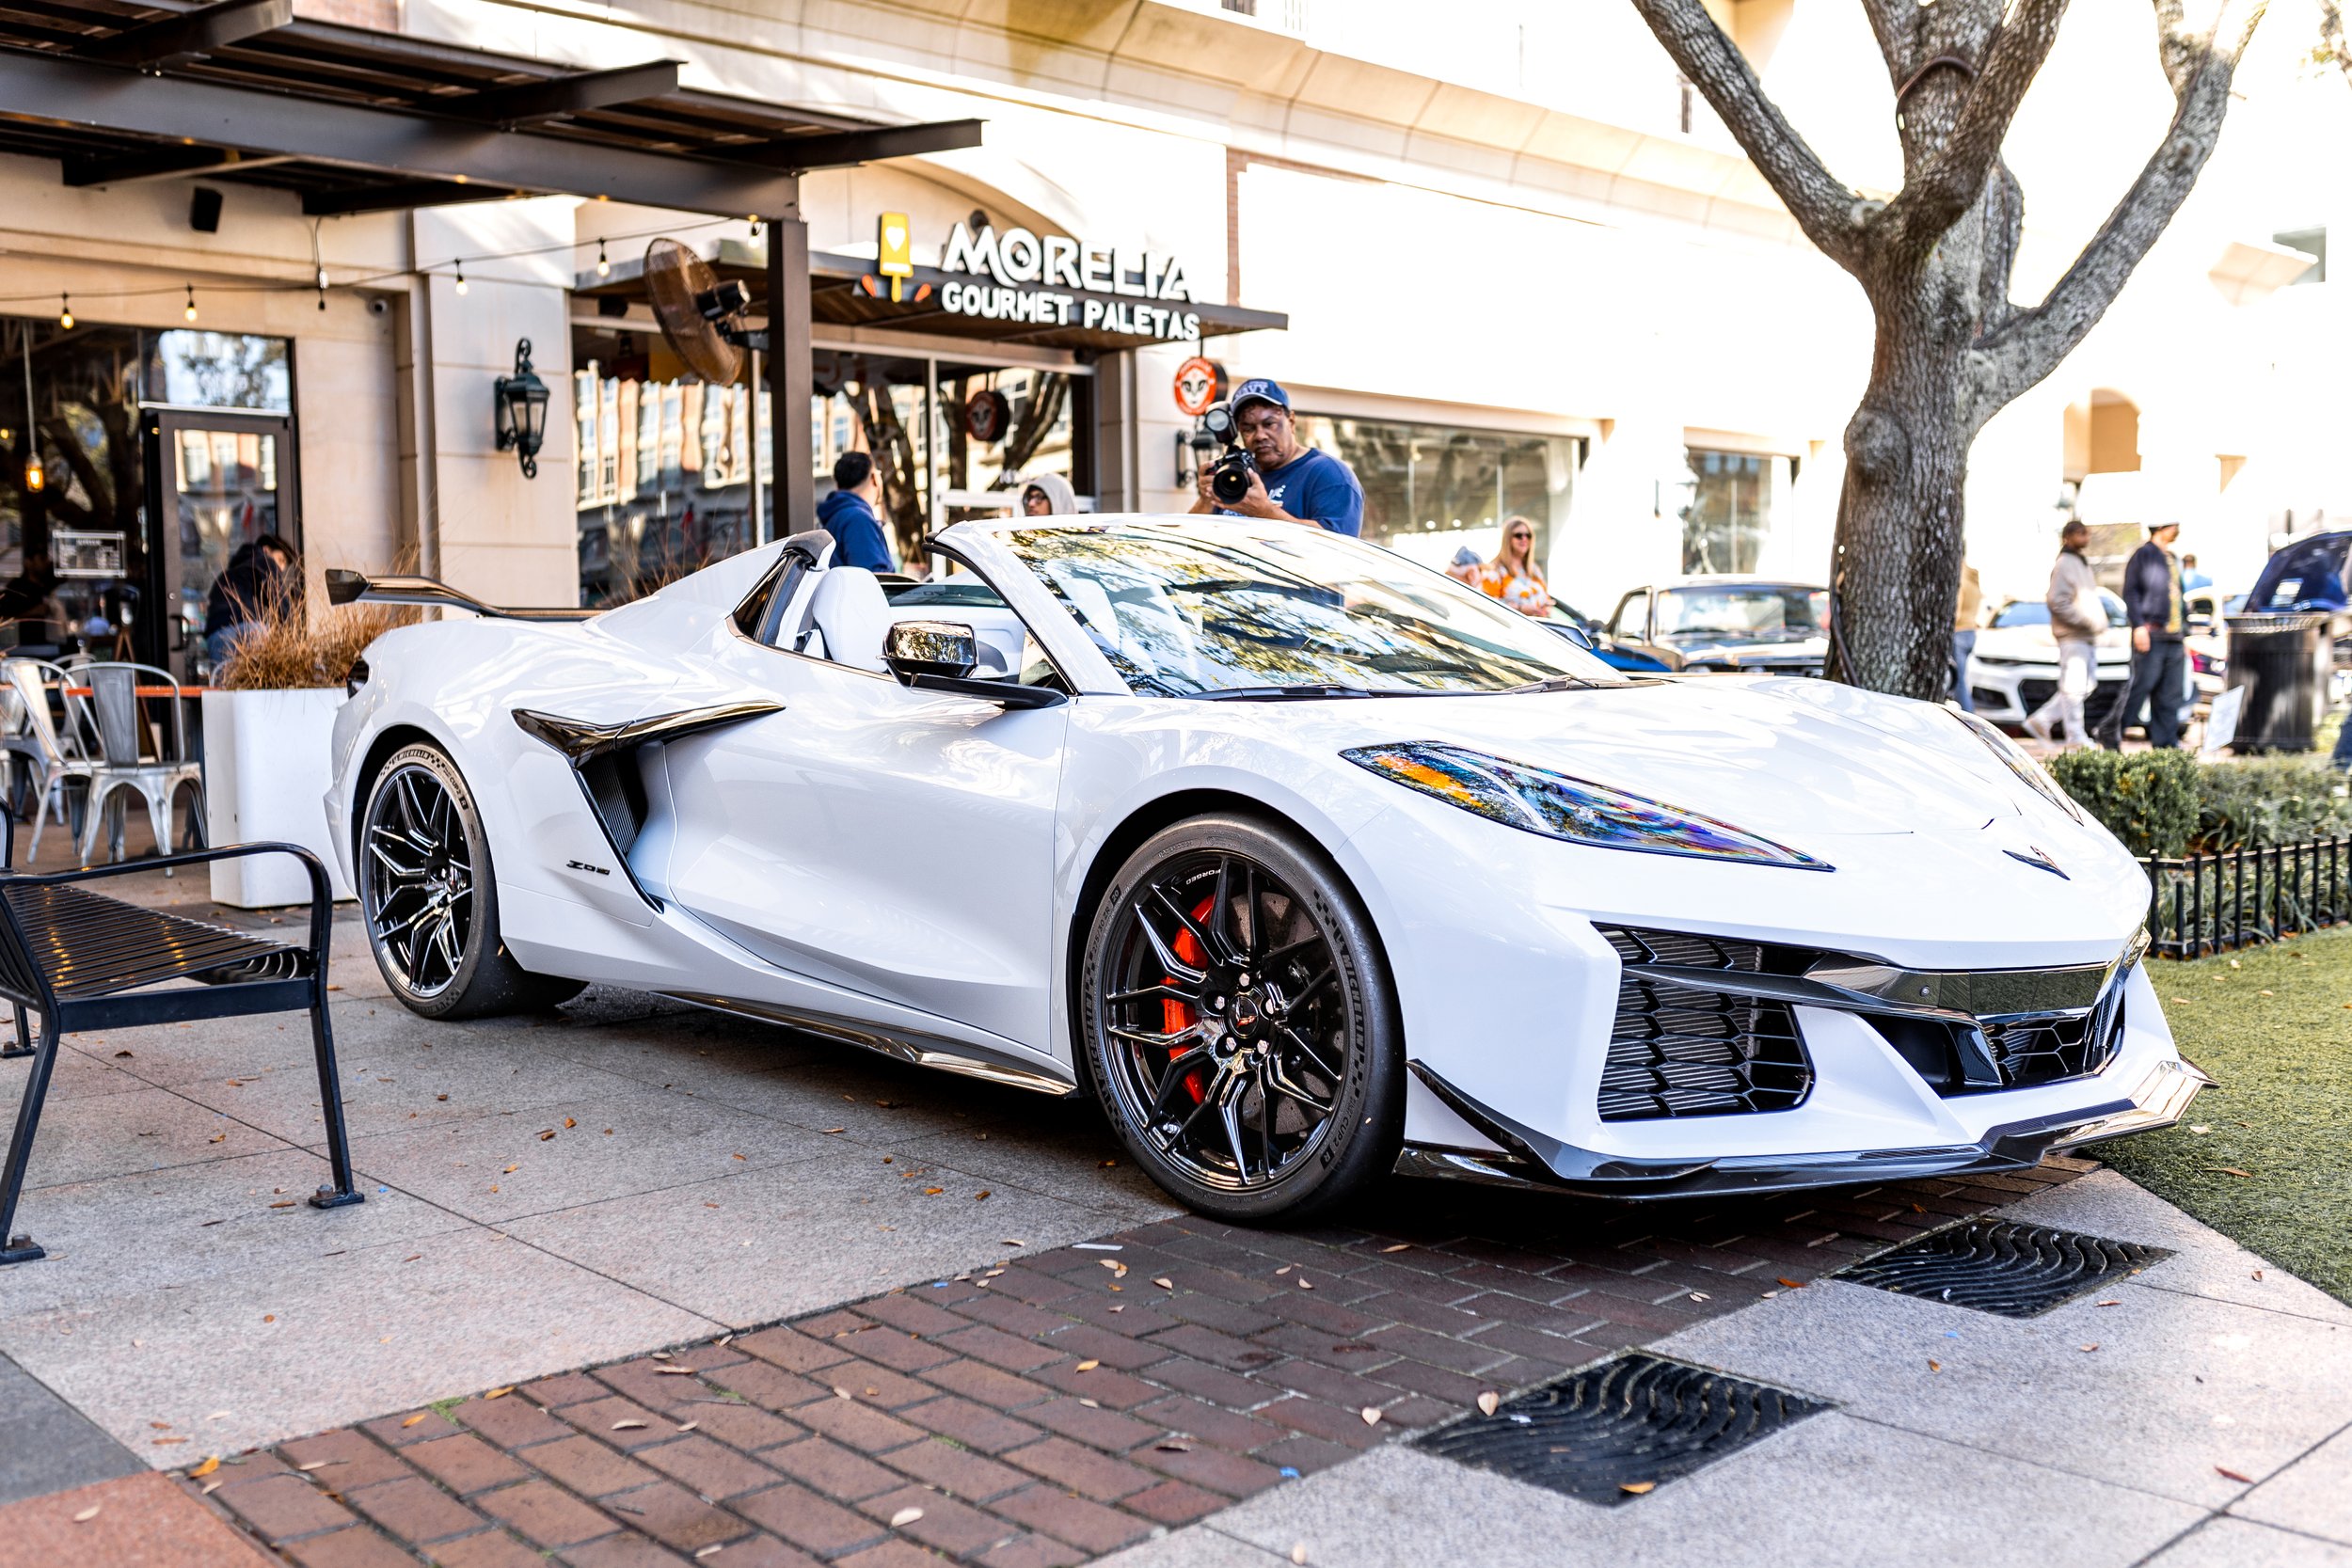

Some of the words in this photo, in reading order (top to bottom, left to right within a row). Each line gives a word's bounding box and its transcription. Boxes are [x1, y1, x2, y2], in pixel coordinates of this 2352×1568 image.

[942, 222, 1201, 305] MORELIA
[942, 282, 1073, 325] GOURMET
[1084, 299, 1200, 341] PALETAS
[1110, 889, 1119, 902] 20
[1185, 868, 1221, 885] FORGED
[1342, 954, 1364, 1048] MICHELIN
[1086, 996, 1104, 1080] MICHELIN
